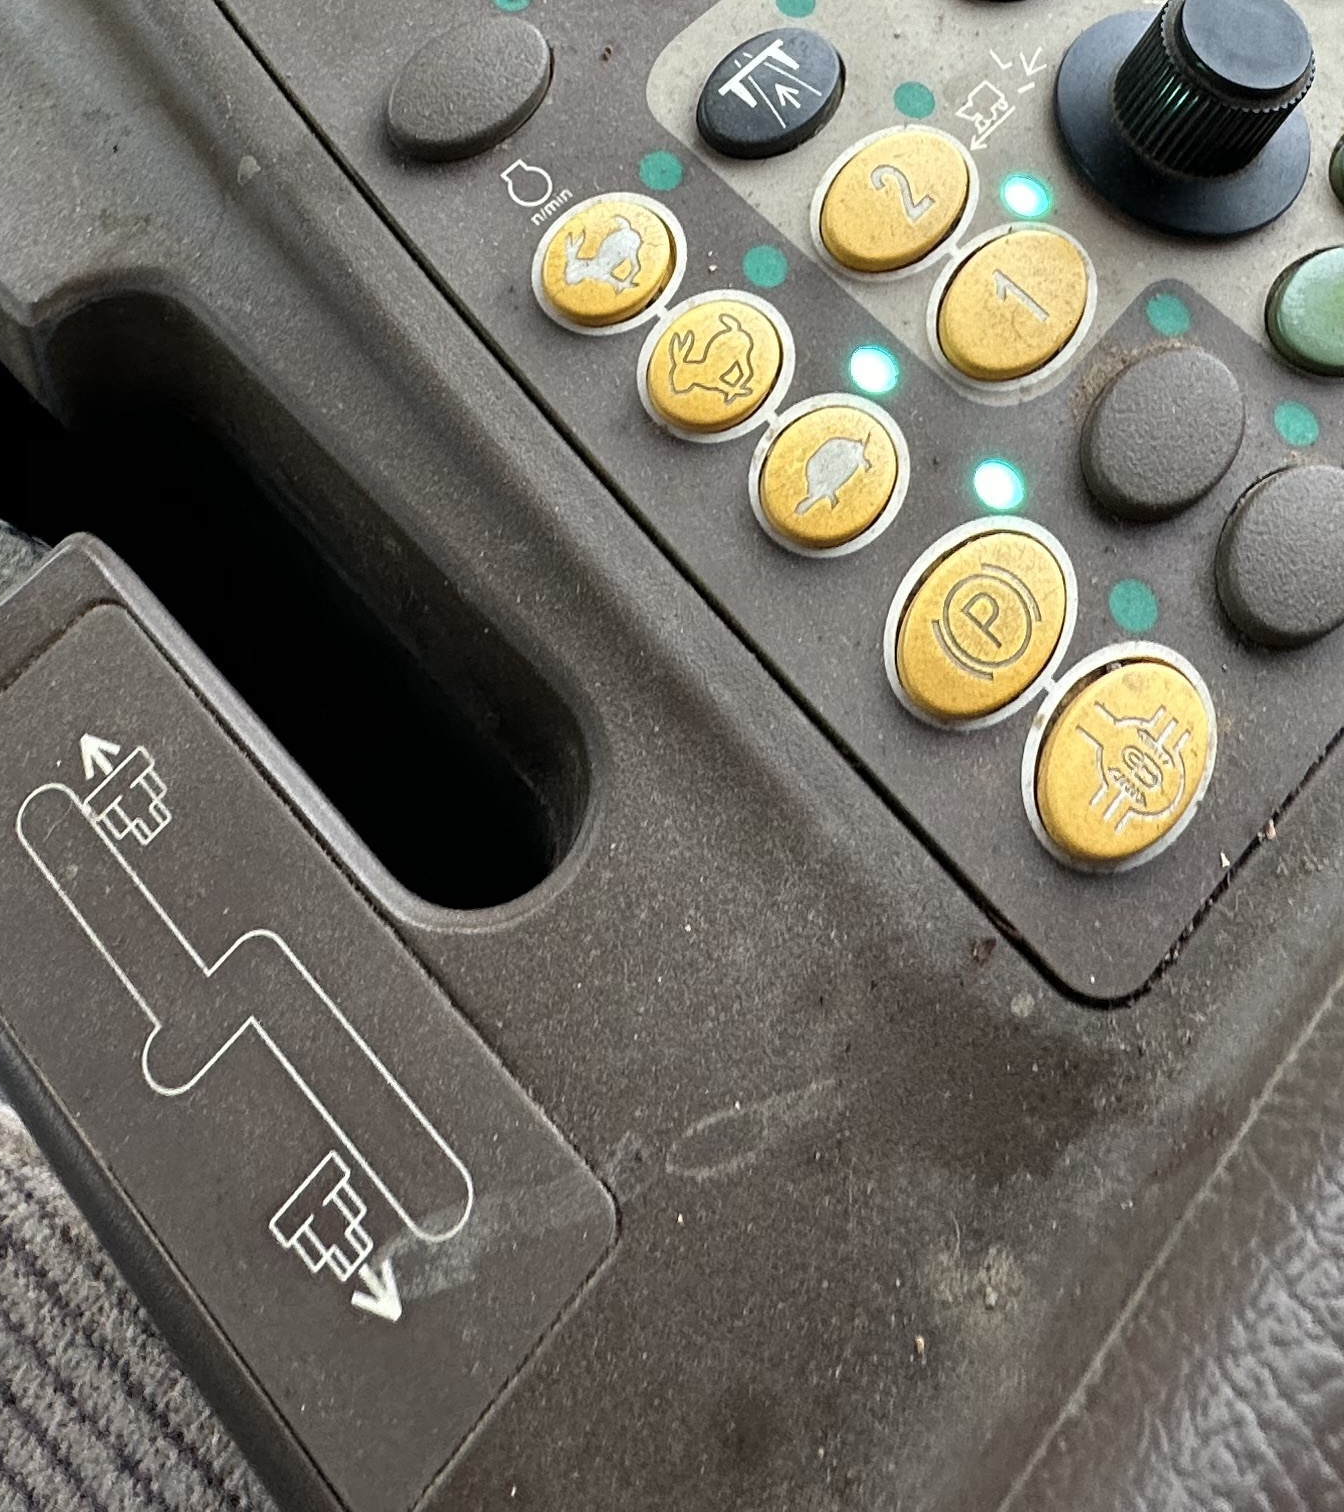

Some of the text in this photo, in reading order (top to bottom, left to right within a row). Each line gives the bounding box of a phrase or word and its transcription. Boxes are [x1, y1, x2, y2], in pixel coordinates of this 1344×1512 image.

[530, 188, 574, 227] n/min
[870, 163, 936, 224] 2
[992, 268, 1050, 323] 1
[960, 591, 1002, 649] P
